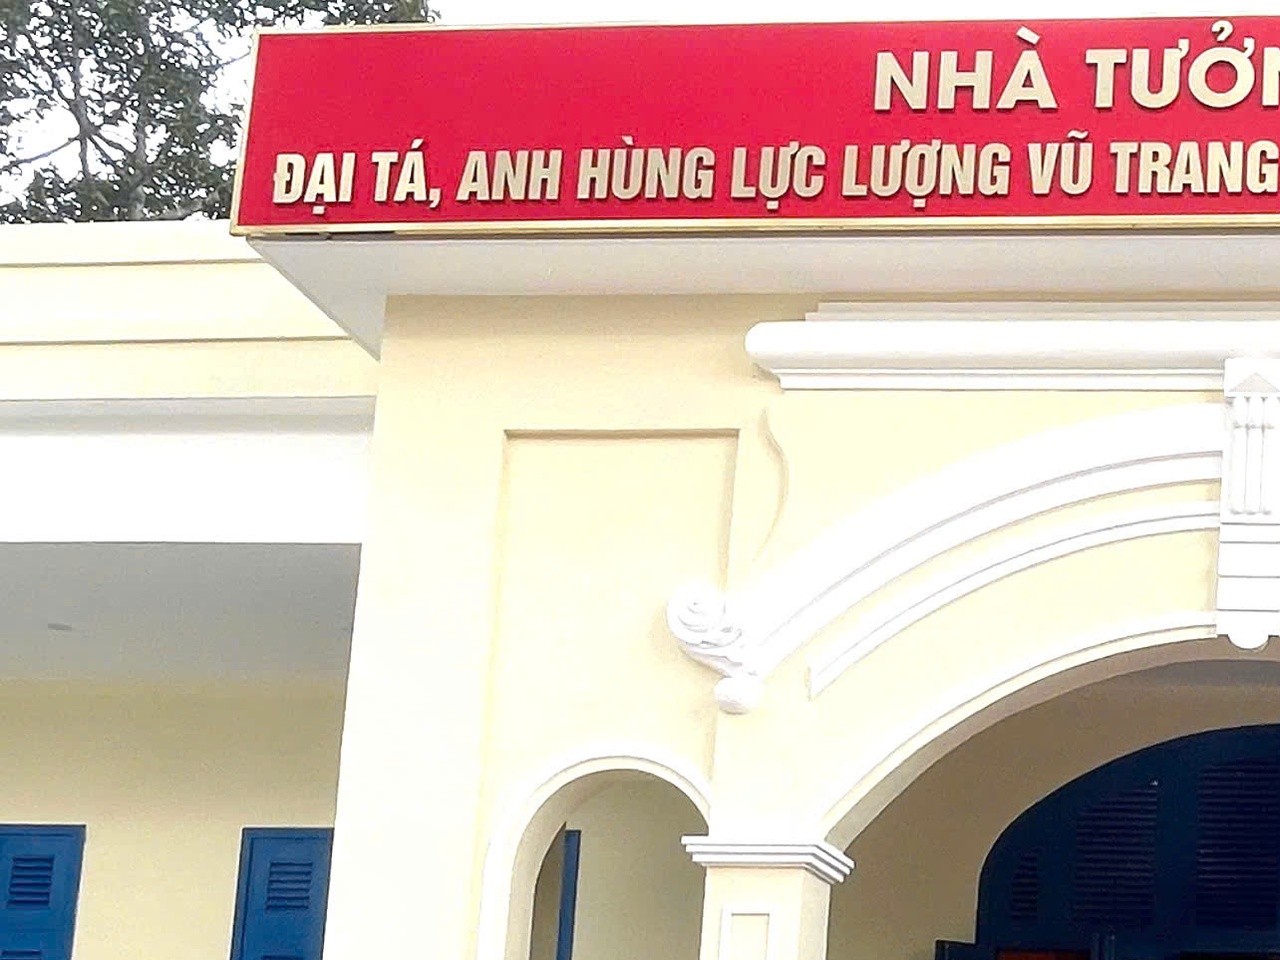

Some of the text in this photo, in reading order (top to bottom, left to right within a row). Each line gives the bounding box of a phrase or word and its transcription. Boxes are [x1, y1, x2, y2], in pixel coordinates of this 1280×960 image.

[873, 25, 1058, 113] NHÀ
[272, 152, 355, 215] ĐẠI
[371, 139, 441, 210] TÁ,
[455, 148, 563, 202] ANH
[576, 135, 715, 201] HÙNG
[730, 141, 825, 210] LỰC
[840, 138, 1010, 209] LƯỢNG
[1027, 131, 1093, 196] VŨ
[1110, 140, 1279, 195] TRANG
